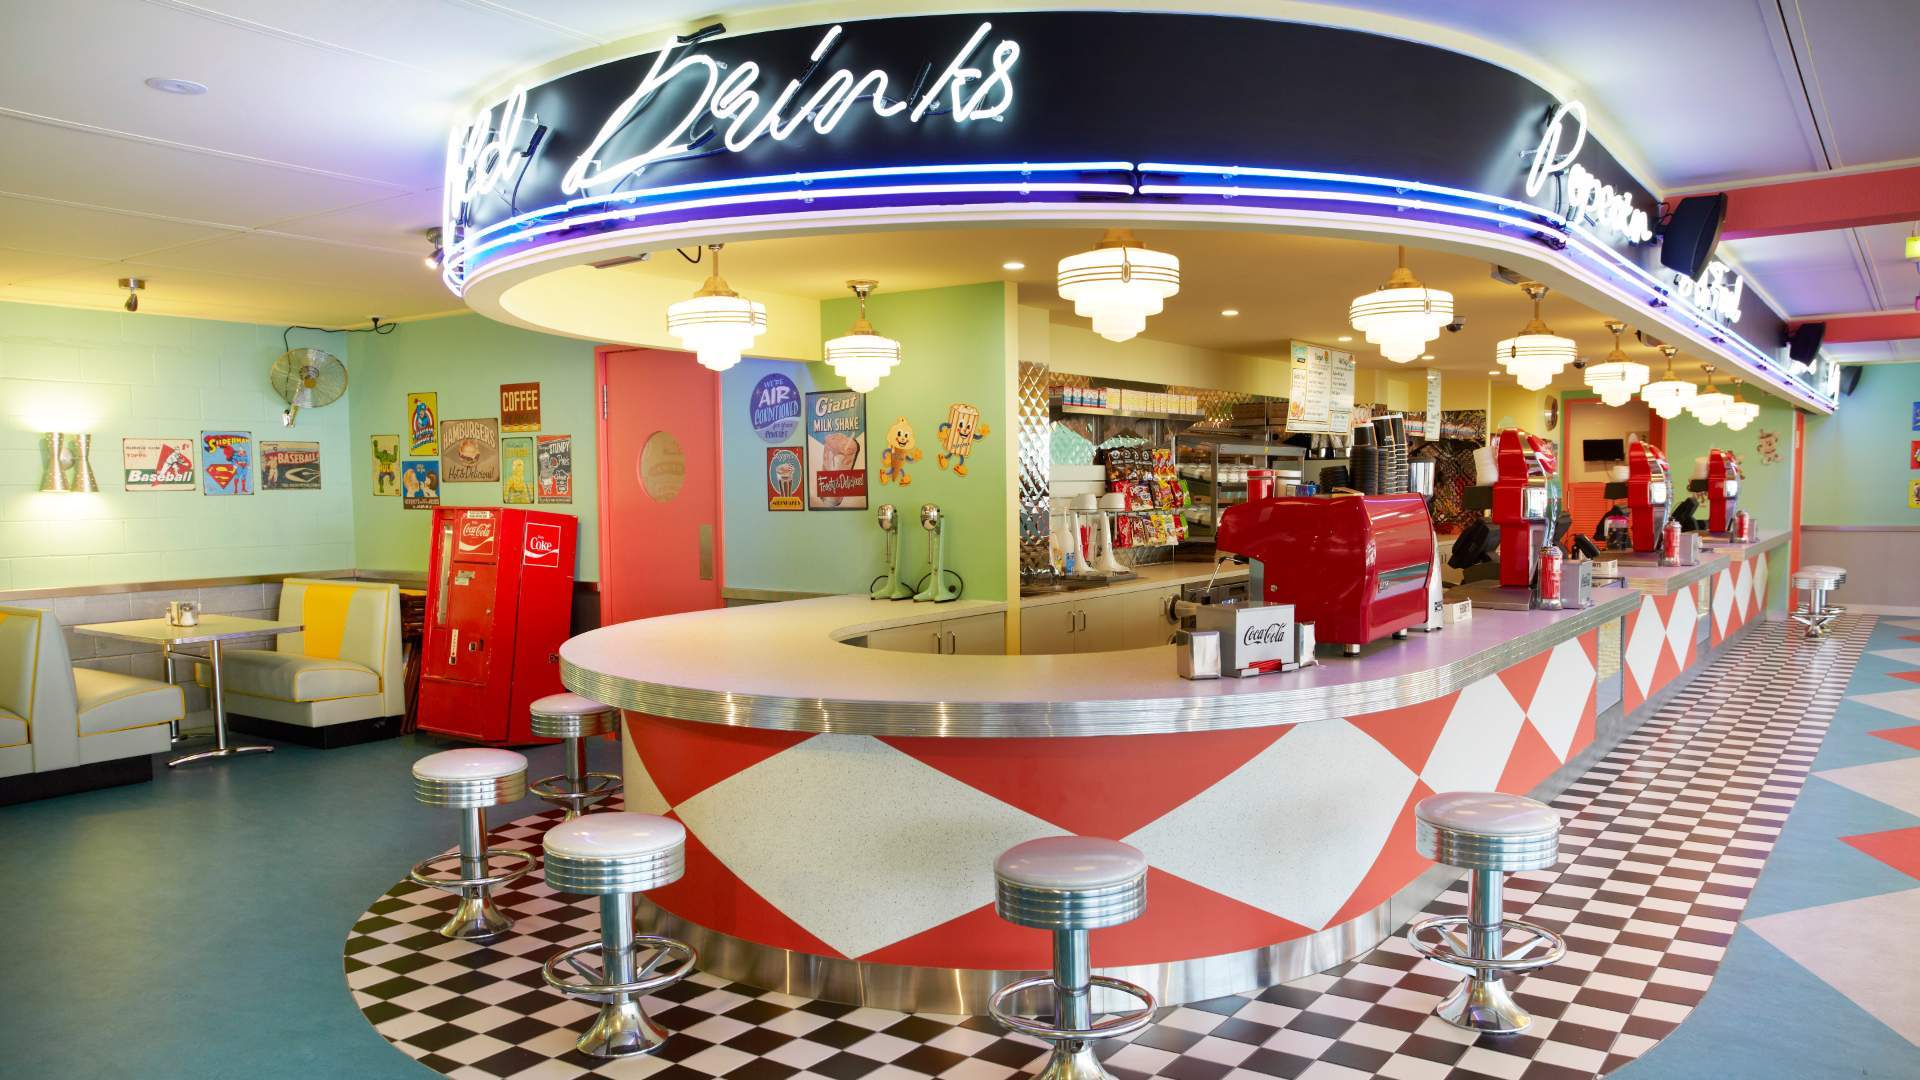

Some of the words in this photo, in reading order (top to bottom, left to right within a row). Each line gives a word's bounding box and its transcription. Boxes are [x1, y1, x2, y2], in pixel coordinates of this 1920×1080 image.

[561, 22, 1020, 195] Drinks
[502, 390, 538, 411] COFFEE
[758, 386, 791, 408] AIR
[815, 394, 857, 416] Giant
[754, 400, 799, 425] CONDITIONED
[814, 420, 833, 432] MILK
[835, 417, 860, 431] SHAKE
[208, 437, 250, 454] SUPERMAN
[443, 422, 496, 450] HAMBURGERS
[277, 453, 316, 464] BASEBALL
[127, 470, 193, 482] Baseball
[448, 466, 459, 479] Hot
[463, 523, 492, 537] Coca-Cola
[530, 537, 552, 551] Coke
[1243, 622, 1287, 646] Coca-Cola
